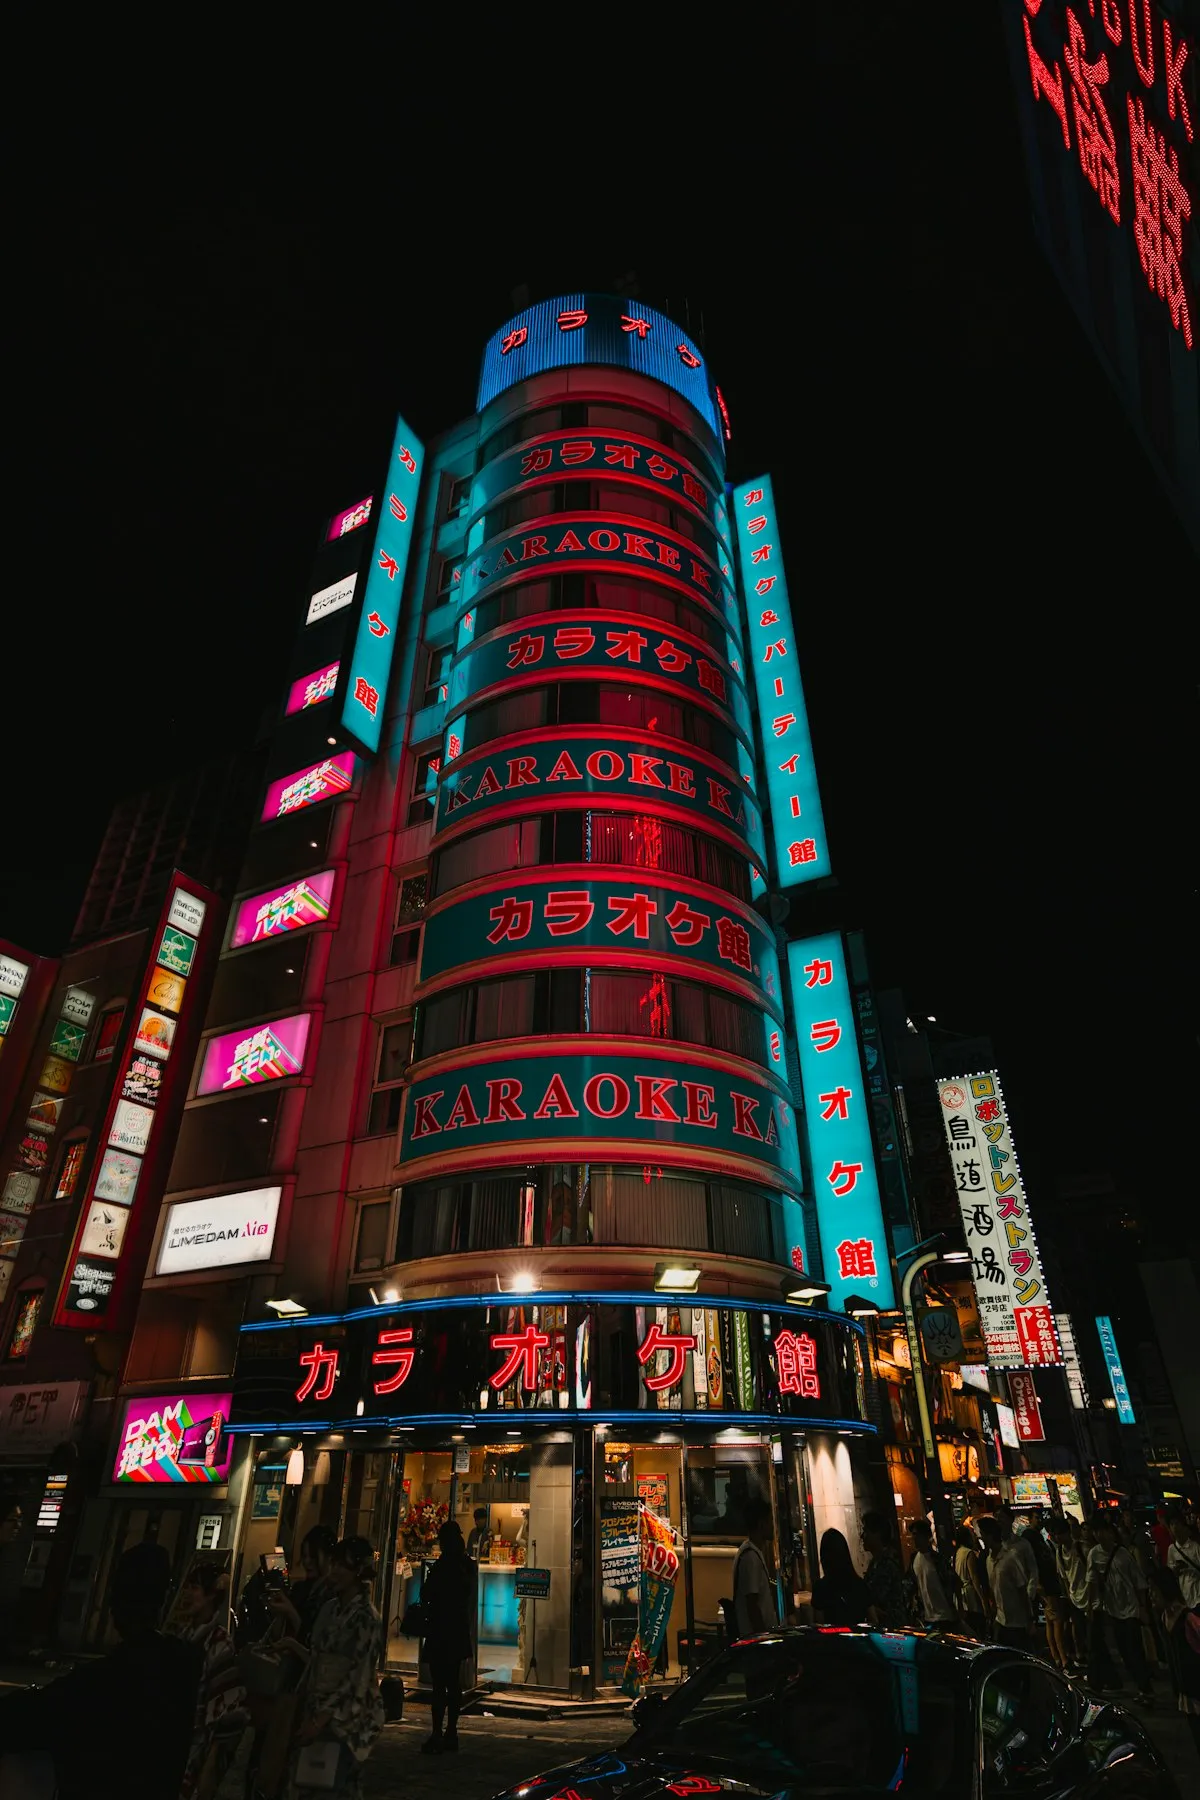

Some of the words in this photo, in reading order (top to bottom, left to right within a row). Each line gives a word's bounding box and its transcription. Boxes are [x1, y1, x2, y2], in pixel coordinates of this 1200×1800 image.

[502, 310, 700, 368] カラオケ
[520, 441, 708, 510] カラオケ館
[354, 444, 417, 716] カラオケ館
[506, 627, 726, 703] カラオケ館
[744, 488, 818, 867] カラオケ&パーティー館
[445, 750, 696, 816] KARAOKE
[486, 890, 752, 972] カラオケ館
[410, 1072, 718, 1141] KARAOKE
[803, 957, 878, 1280] カラオケ館
[970, 1075, 1041, 1305] ロボットレストラン
[296, 1323, 821, 1402] カラオケ館
[125, 1399, 184, 1441] DAM
[1011, 1376, 1032, 1436] Orange
